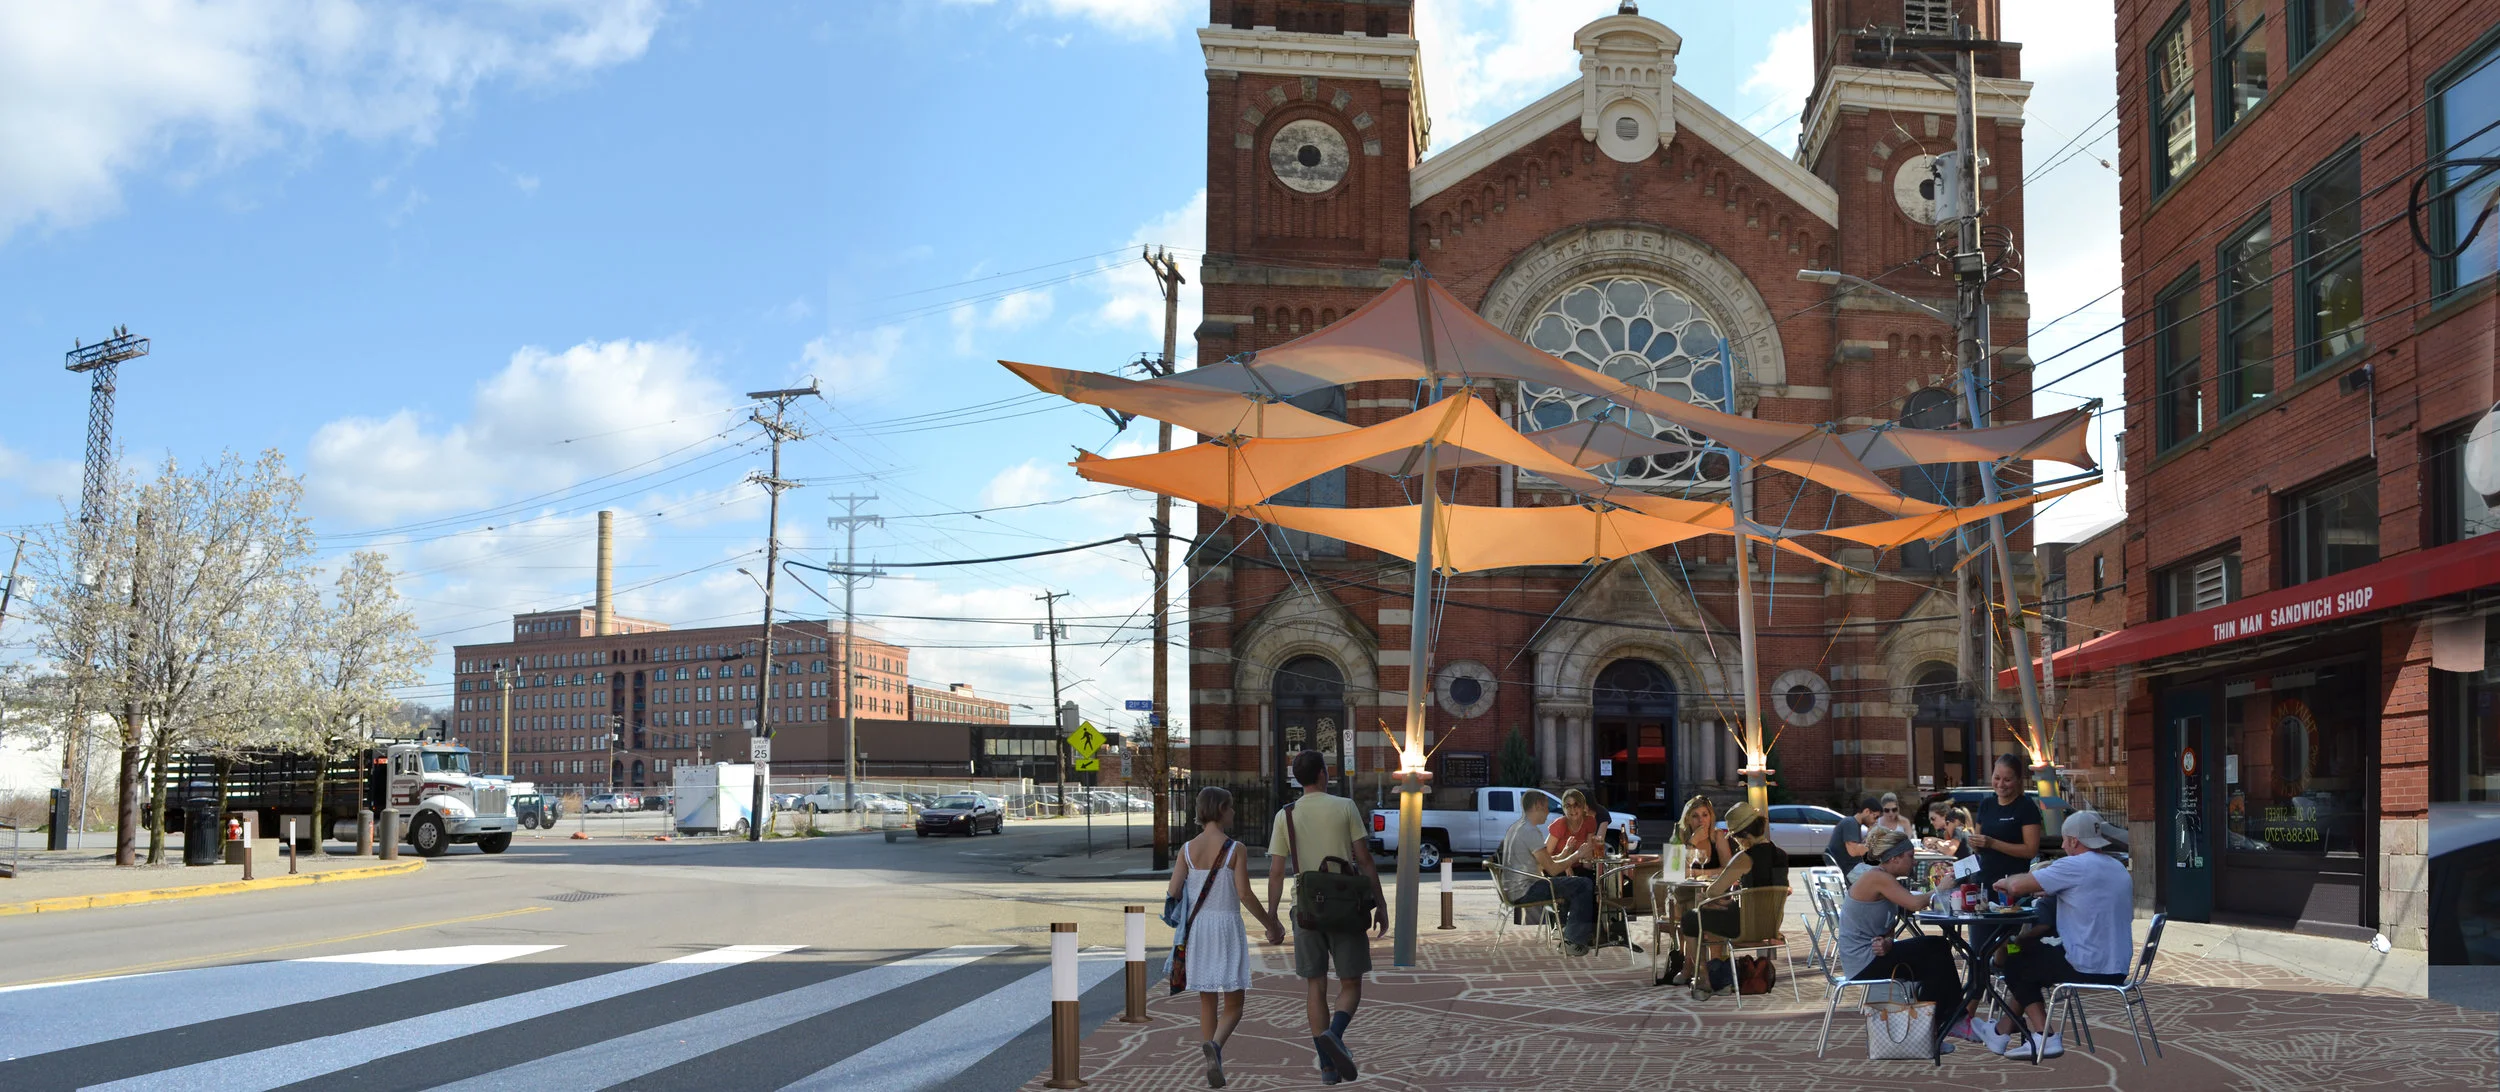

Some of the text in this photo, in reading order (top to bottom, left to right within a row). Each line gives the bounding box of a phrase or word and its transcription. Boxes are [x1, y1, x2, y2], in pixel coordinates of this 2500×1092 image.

[1691, 254, 1769, 349] GLORIAM
[2213, 586, 2373, 641] THIN MAN SANDWICH SHOP
[754, 749, 767, 758] 25
